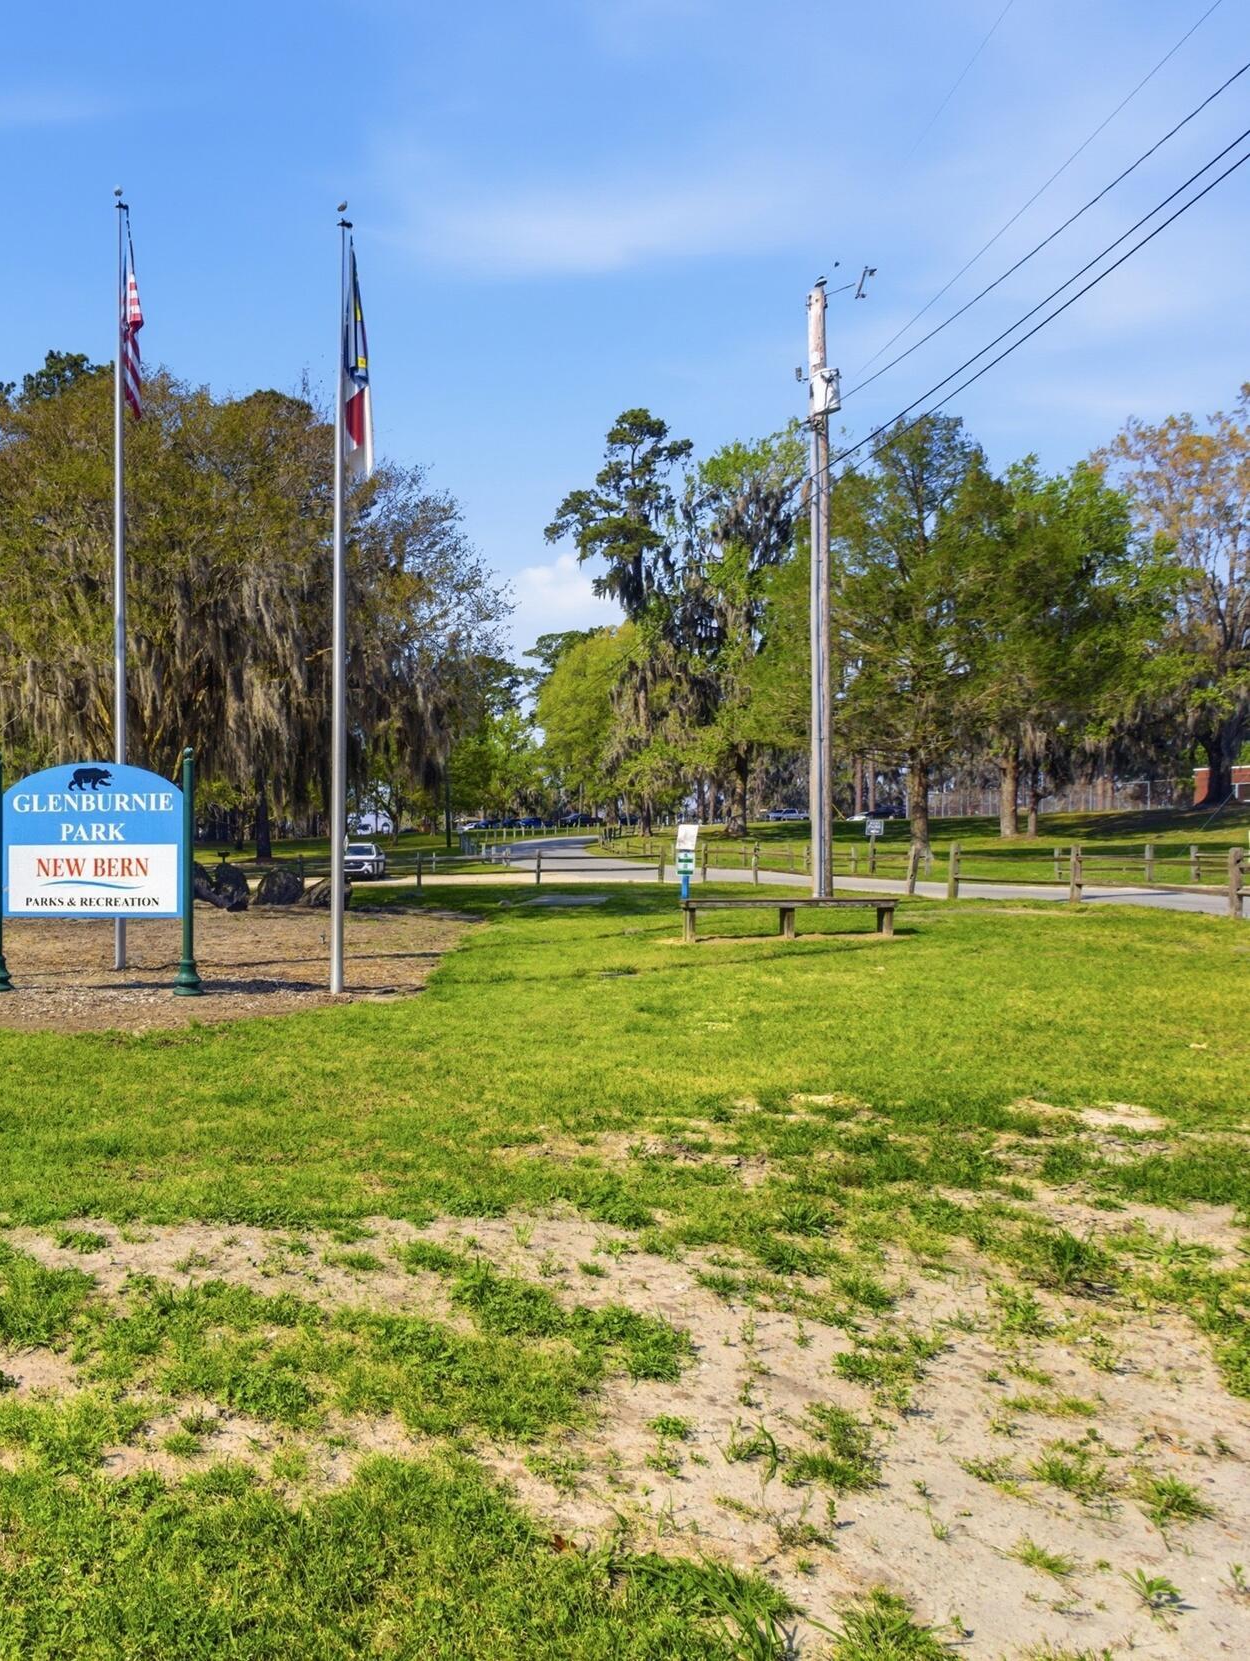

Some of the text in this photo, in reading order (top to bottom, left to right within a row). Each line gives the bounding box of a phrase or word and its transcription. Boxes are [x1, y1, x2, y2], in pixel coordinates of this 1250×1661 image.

[13, 793, 173, 812] GLENBURNIE
[61, 823, 126, 841] PARK
[36, 858, 149, 877] NEW BERN
[25, 897, 160, 907] PARKS & RECREATION
